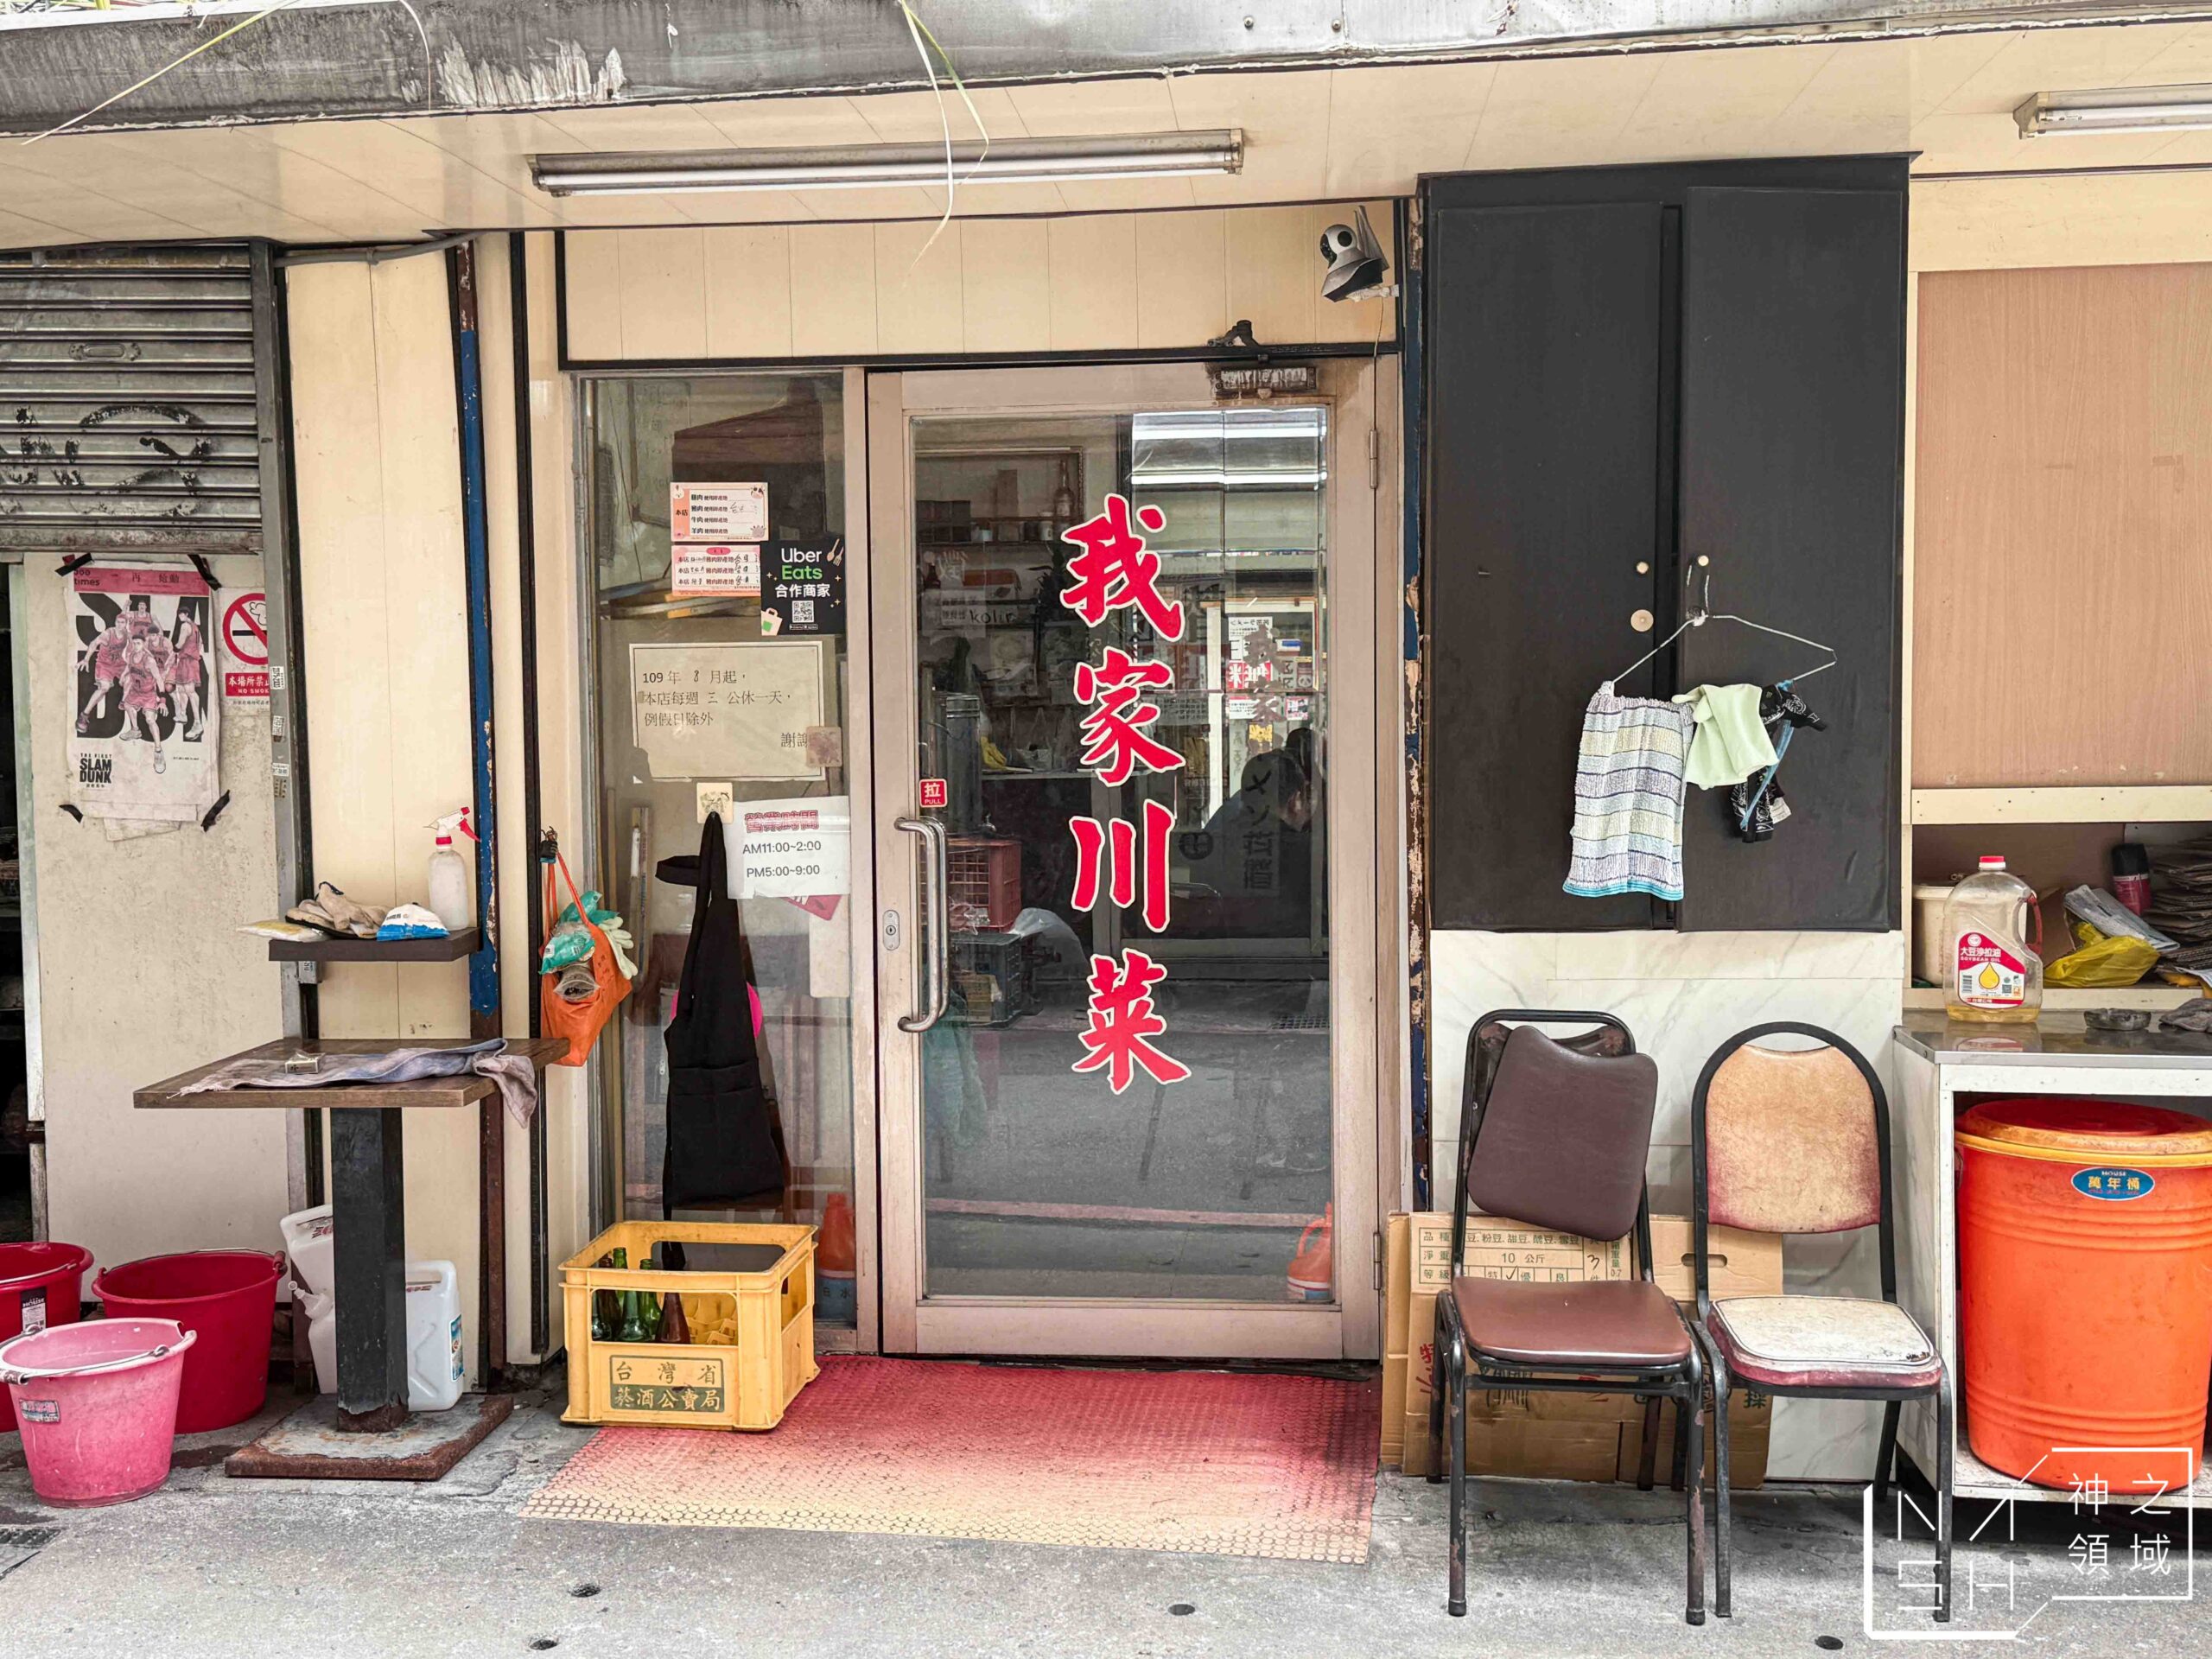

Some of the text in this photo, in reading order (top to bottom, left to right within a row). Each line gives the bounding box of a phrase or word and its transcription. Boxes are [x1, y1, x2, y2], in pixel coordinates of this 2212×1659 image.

[781, 547, 822, 563] Uber
[781, 565, 823, 580] Eats
[775, 583, 830, 598] 合作商家
[643, 672, 664, 683] 109
[668, 671, 681, 684] 年
[645, 691, 699, 705] 本店每週
[708, 692, 718, 704] 三
[645, 712, 714, 727] 例假日除外
[79, 758, 112, 772] SLAM
[79, 770, 111, 784] DUNK
[925, 782, 941, 798] 拉
[1060, 493, 1192, 1096] 我家川菜
[742, 840, 822, 854] AM11:00~2:00
[747, 864, 820, 878] PM5:00~9:00
[1502, 1253, 1516, 1263] 10
[1524, 1254, 1545, 1263] 公斤
[616, 1361, 716, 1384] 台灣省
[614, 1386, 721, 1411] 菸酒公賣局
